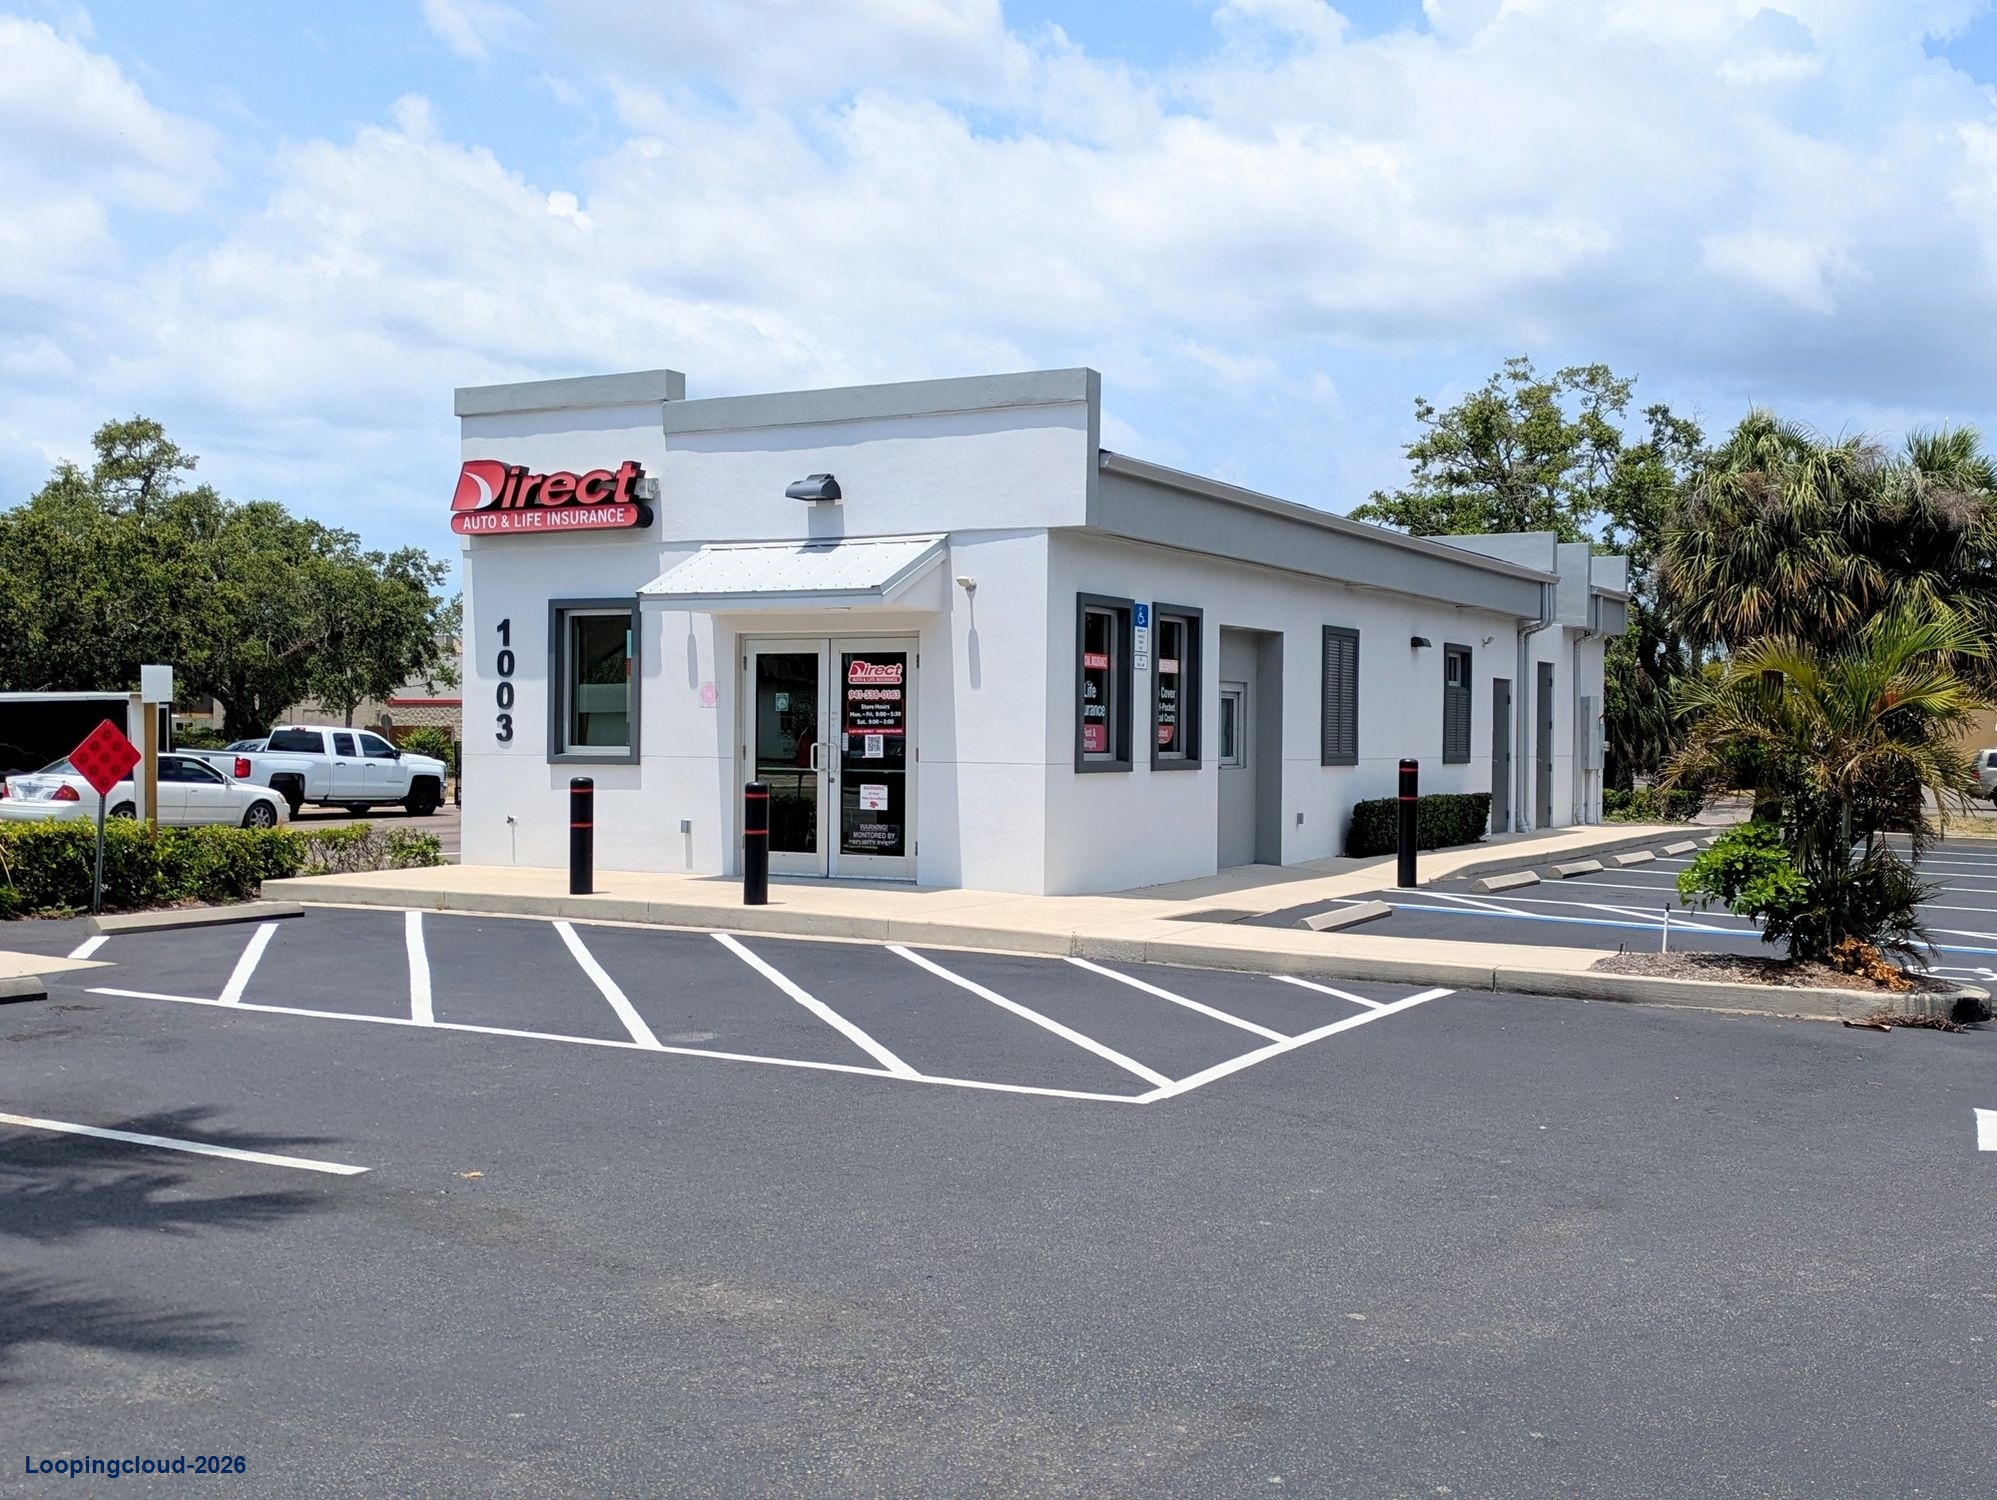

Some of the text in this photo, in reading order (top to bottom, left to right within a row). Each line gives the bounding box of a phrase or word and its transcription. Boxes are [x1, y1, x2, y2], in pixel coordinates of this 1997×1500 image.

[450, 460, 638, 511] Direct
[463, 508, 625, 530] AUTO & LIFE INSURANCE
[495, 618, 515, 742] 1003
[849, 662, 902, 676] Direct
[1084, 681, 1097, 698] Life
